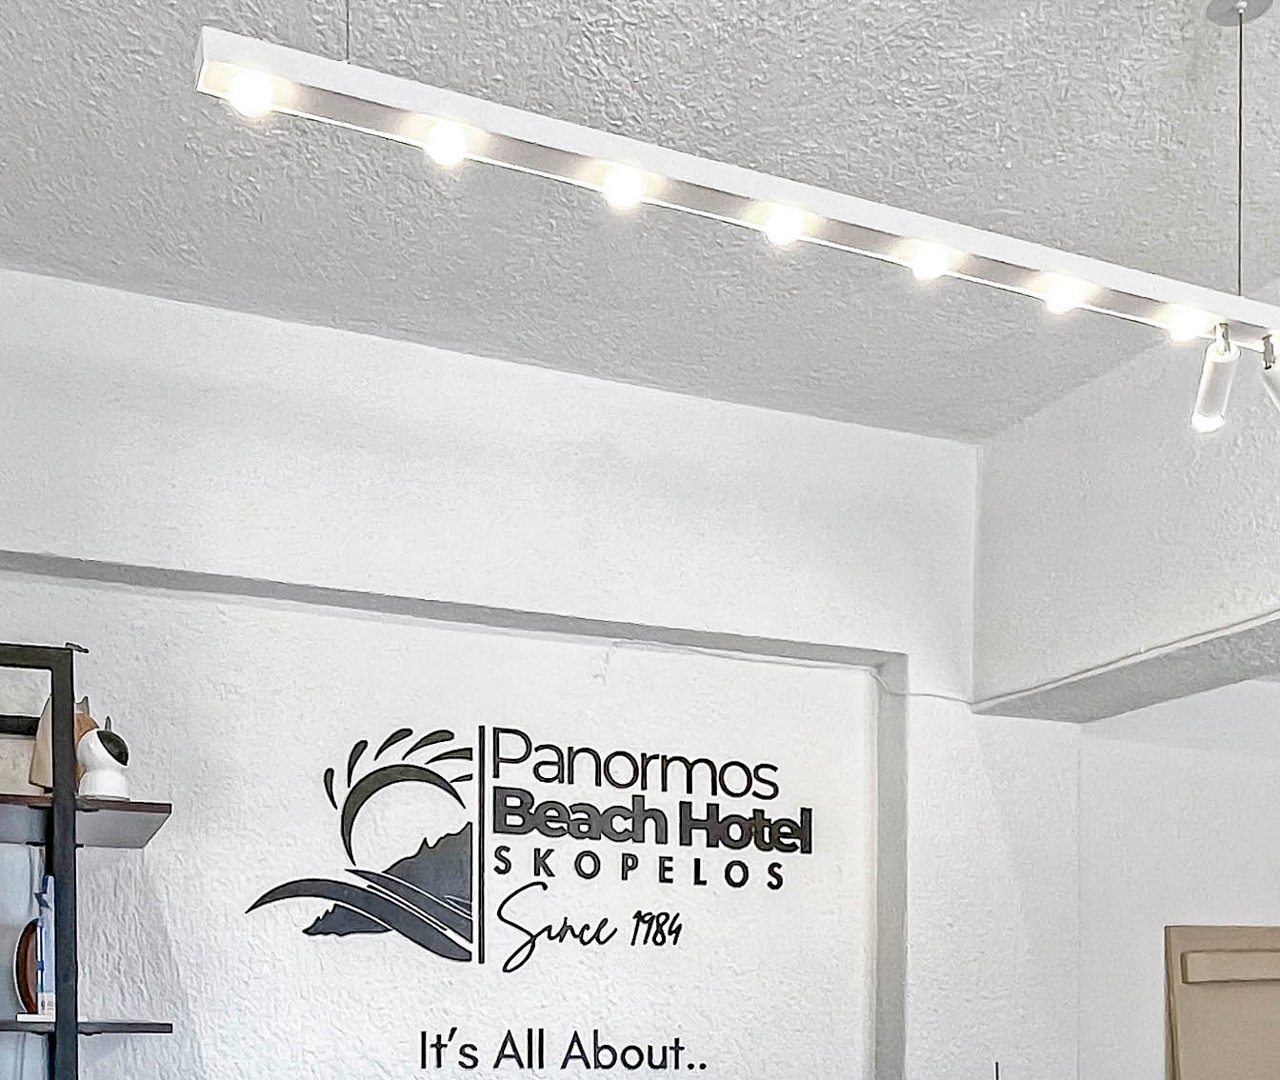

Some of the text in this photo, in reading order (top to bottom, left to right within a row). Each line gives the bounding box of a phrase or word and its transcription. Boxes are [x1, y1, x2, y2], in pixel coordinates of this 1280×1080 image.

[492, 726, 779, 801] Panormos
[492, 786, 813, 854] Beach Hotel
[494, 846, 784, 889] SKOPELOS
[497, 882, 683, 973] Since 1984
[420, 1027, 707, 1070] It's All About..
